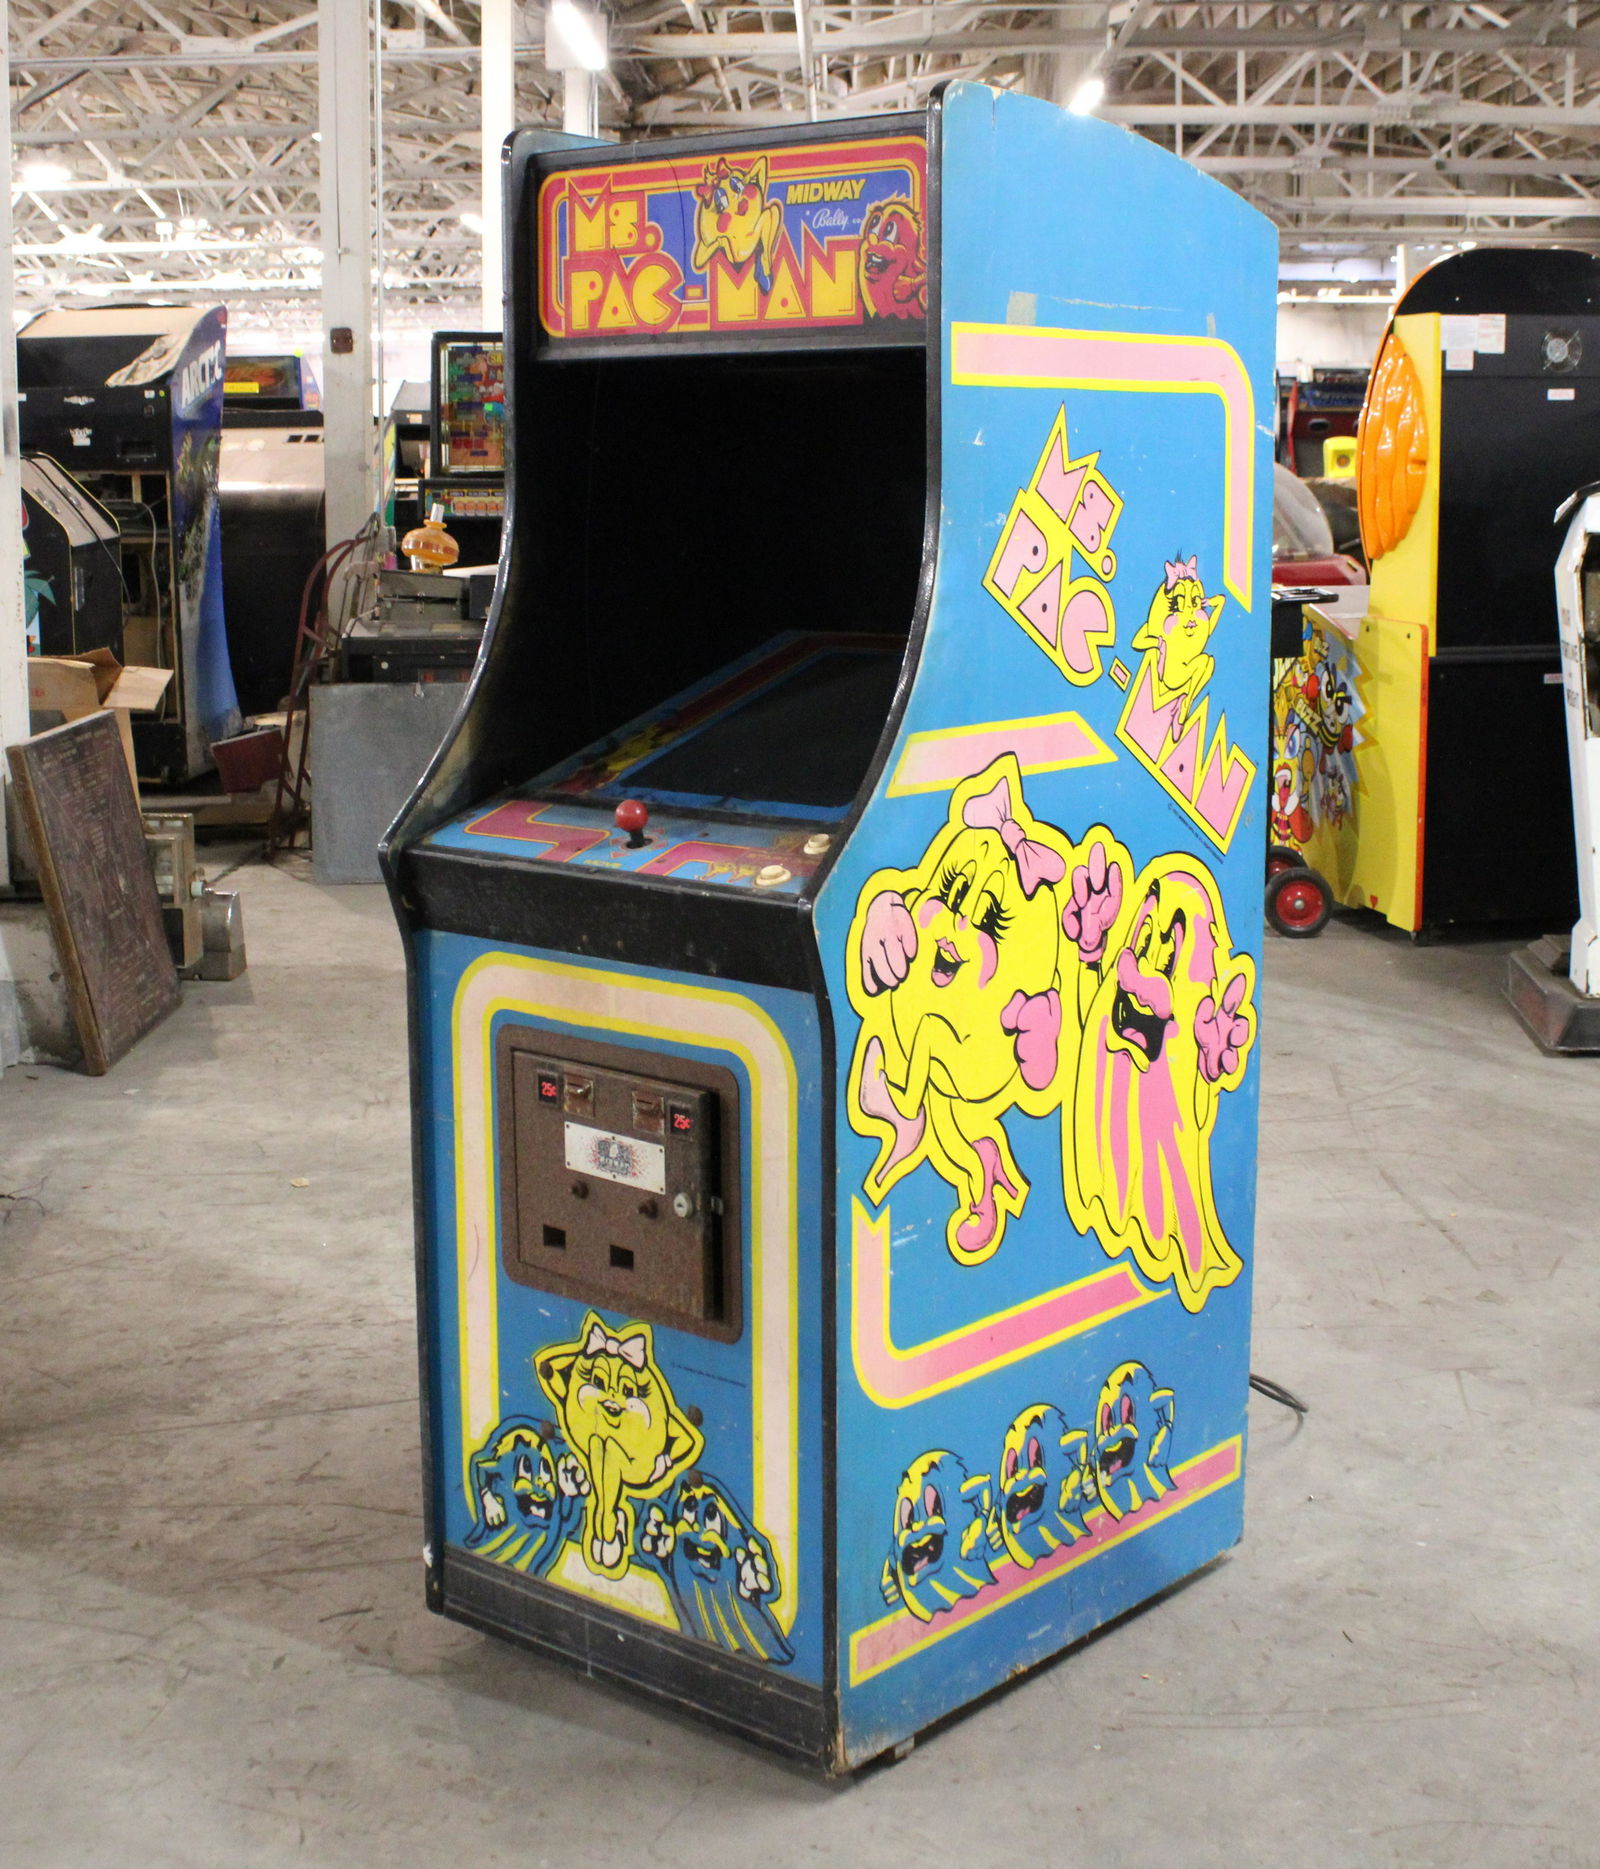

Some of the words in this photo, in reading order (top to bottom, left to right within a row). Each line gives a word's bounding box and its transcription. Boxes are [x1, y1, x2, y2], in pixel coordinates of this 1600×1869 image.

[786, 178, 867, 205] MIDWAY
[812, 208, 849, 231] Bally
[567, 235, 863, 335] PAC-MAN
[985, 492, 1254, 852] PAC-MAN
